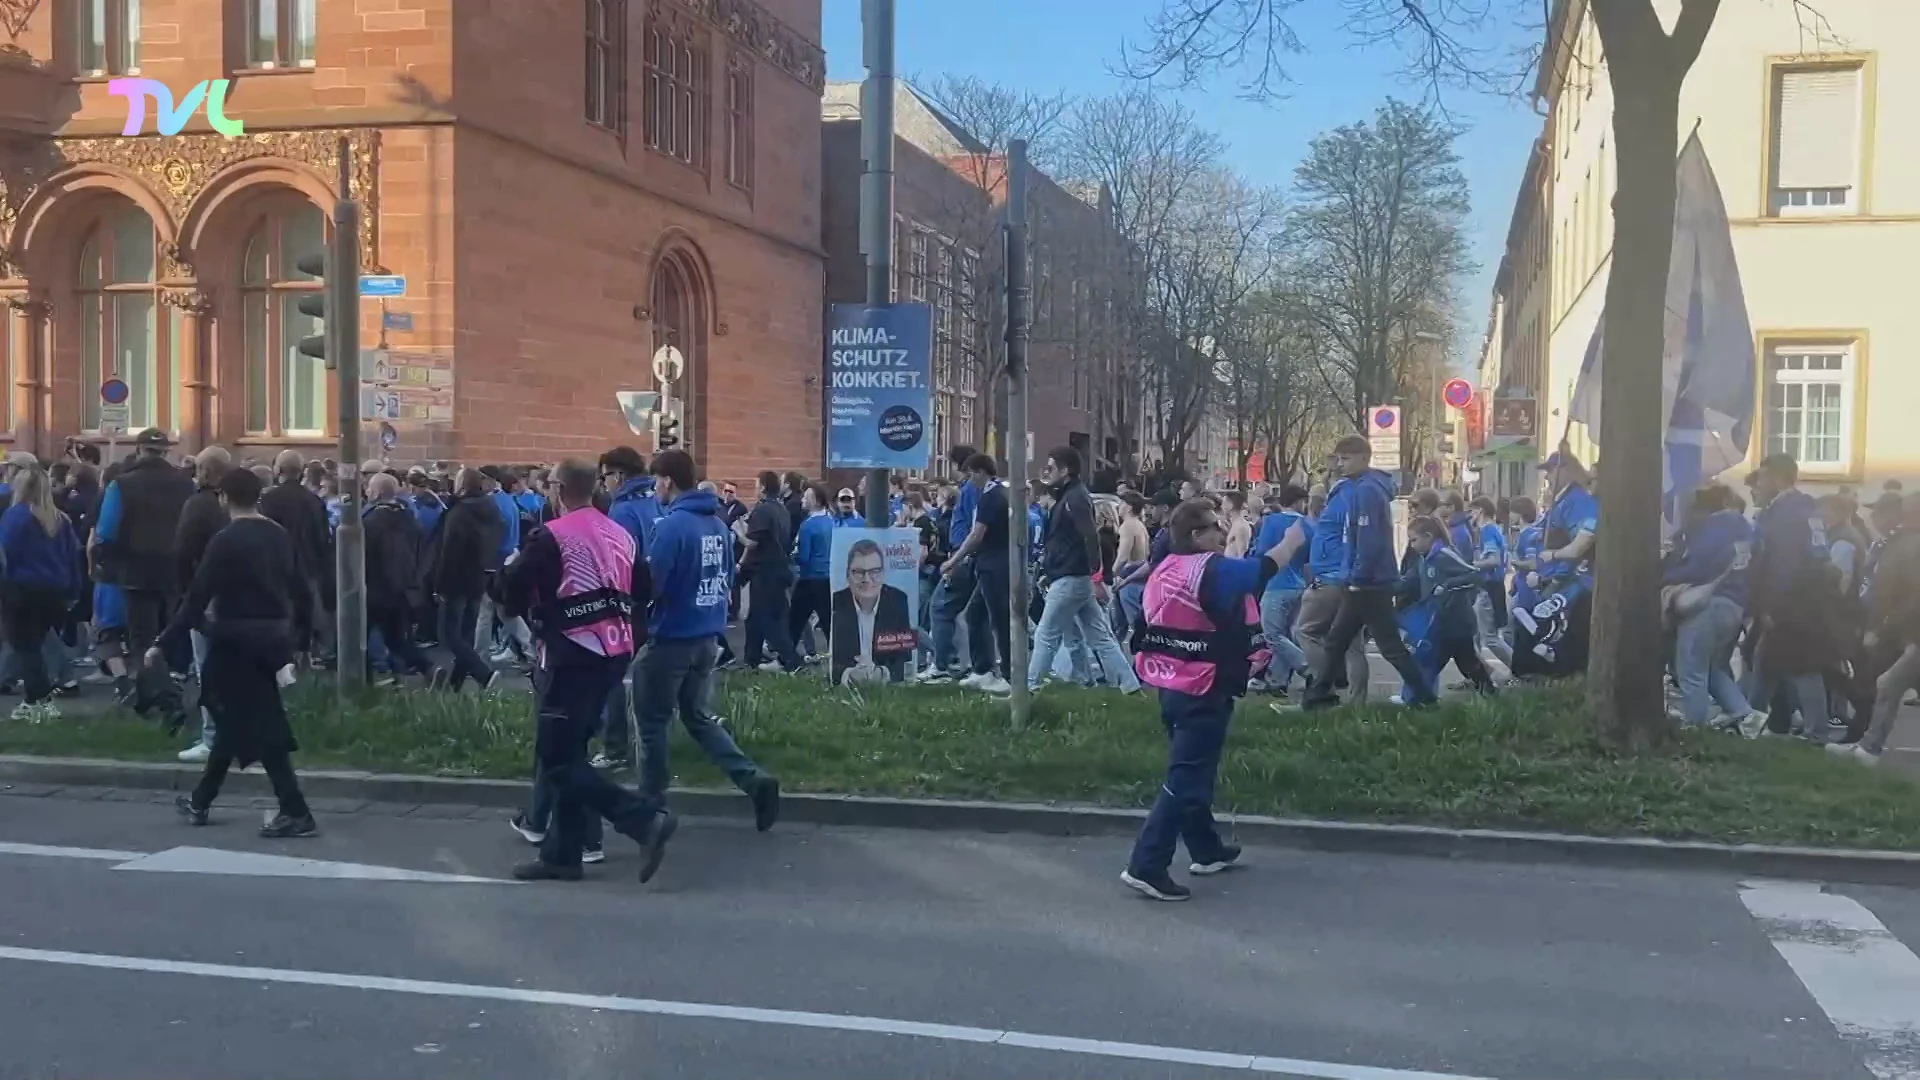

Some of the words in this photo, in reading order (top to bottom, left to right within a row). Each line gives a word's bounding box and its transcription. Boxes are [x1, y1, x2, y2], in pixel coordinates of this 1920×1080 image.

[831, 327, 897, 346] KLIMA-
[831, 349, 909, 367] SCHUTZ
[831, 371, 925, 388] KONKRET.
